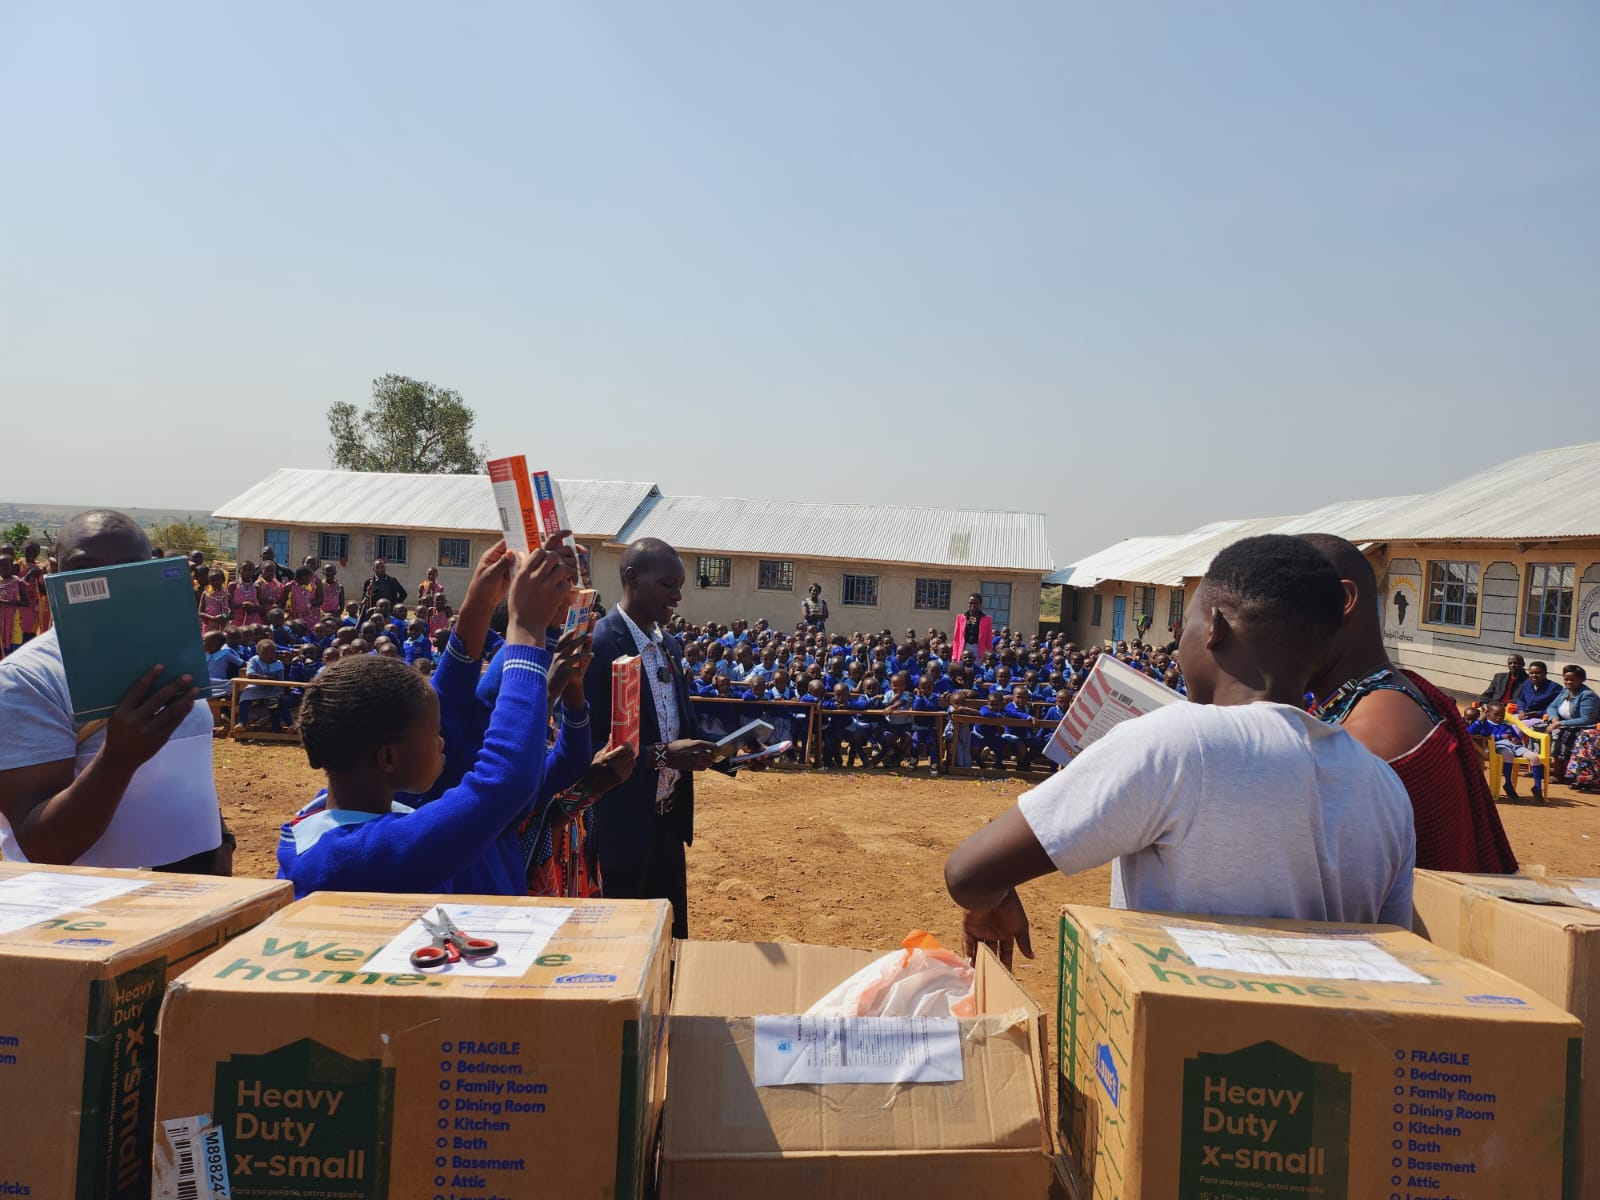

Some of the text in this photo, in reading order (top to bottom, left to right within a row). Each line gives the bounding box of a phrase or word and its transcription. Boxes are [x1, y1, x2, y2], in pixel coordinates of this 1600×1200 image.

[214, 958, 442, 987] home.
[1148, 963, 1370, 1001] home.
[114, 980, 154, 1007] Heavy
[113, 1002, 144, 1026] Duty
[0, 1036, 19, 1047] om
[458, 1041, 520, 1055] FRAGILE
[1411, 1050, 1470, 1066] FRAGILE
[457, 1060, 522, 1074] Bedroom
[1410, 1068, 1472, 1084] Bedroom
[456, 1079, 548, 1095] Family Room
[1204, 1075, 1304, 1115] Heavy
[1409, 1086, 1496, 1103] Family Room
[237, 1079, 344, 1116] Heavy
[116, 1022, 145, 1192] x-small
[455, 1098, 546, 1114] Dining Room
[1409, 1103, 1495, 1121] Dining Room
[235, 1112, 316, 1147] Duty
[454, 1117, 510, 1131] Kitchen
[1202, 1106, 1278, 1143] Duty
[1408, 1121, 1462, 1137] Kitchen
[453, 1136, 488, 1150] Bath
[1408, 1139, 1441, 1153] Bath
[205, 1131, 226, 1197] M89824
[232, 1149, 365, 1180] x-small
[452, 1155, 525, 1170] Basement
[1201, 1145, 1325, 1176] x-small
[1407, 1157, 1476, 1174] Basement
[0, 1180, 31, 1196] ricks
[451, 1173, 487, 1188] Attic
[1406, 1175, 1440, 1190] Attic
